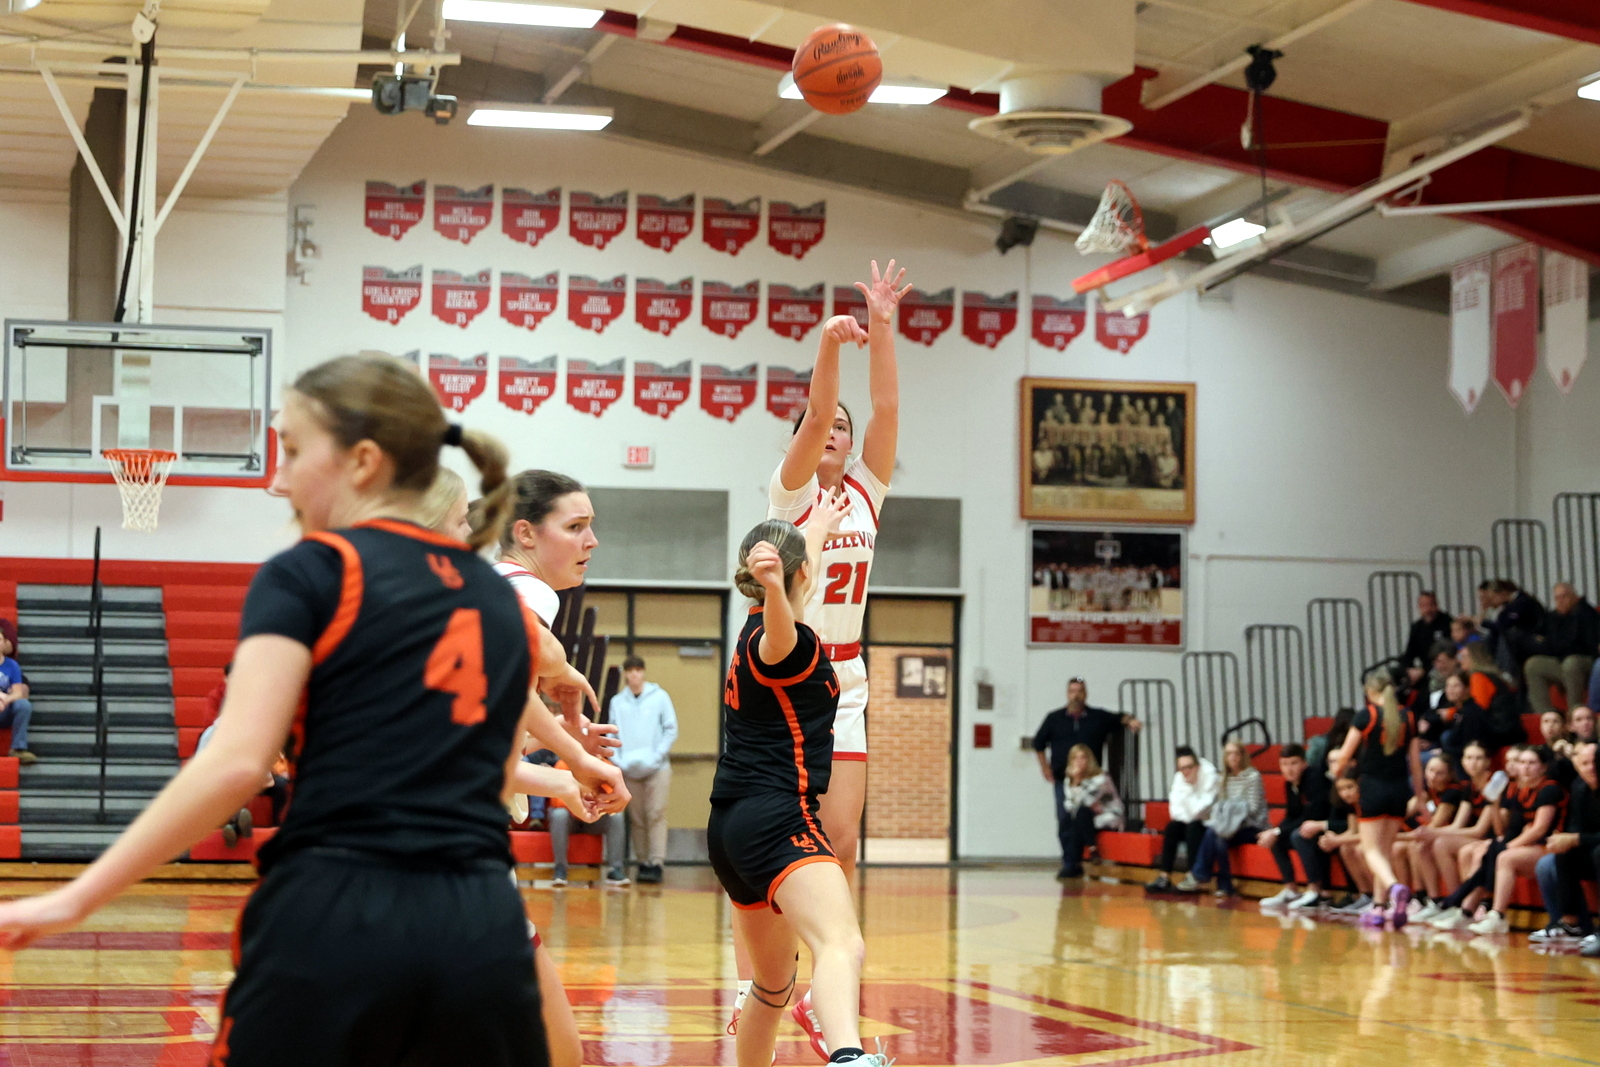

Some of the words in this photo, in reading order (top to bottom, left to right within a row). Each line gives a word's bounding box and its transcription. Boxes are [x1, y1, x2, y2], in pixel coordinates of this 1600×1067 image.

[364, 286, 390, 297] GIRLS
[391, 287, 419, 298] CROSS
[370, 295, 413, 306] COUNTRY
[627, 445, 650, 464] EXIT
[821, 530, 875, 552] ELLEVU
[822, 561, 869, 605] 21
[423, 607, 490, 727] 4
